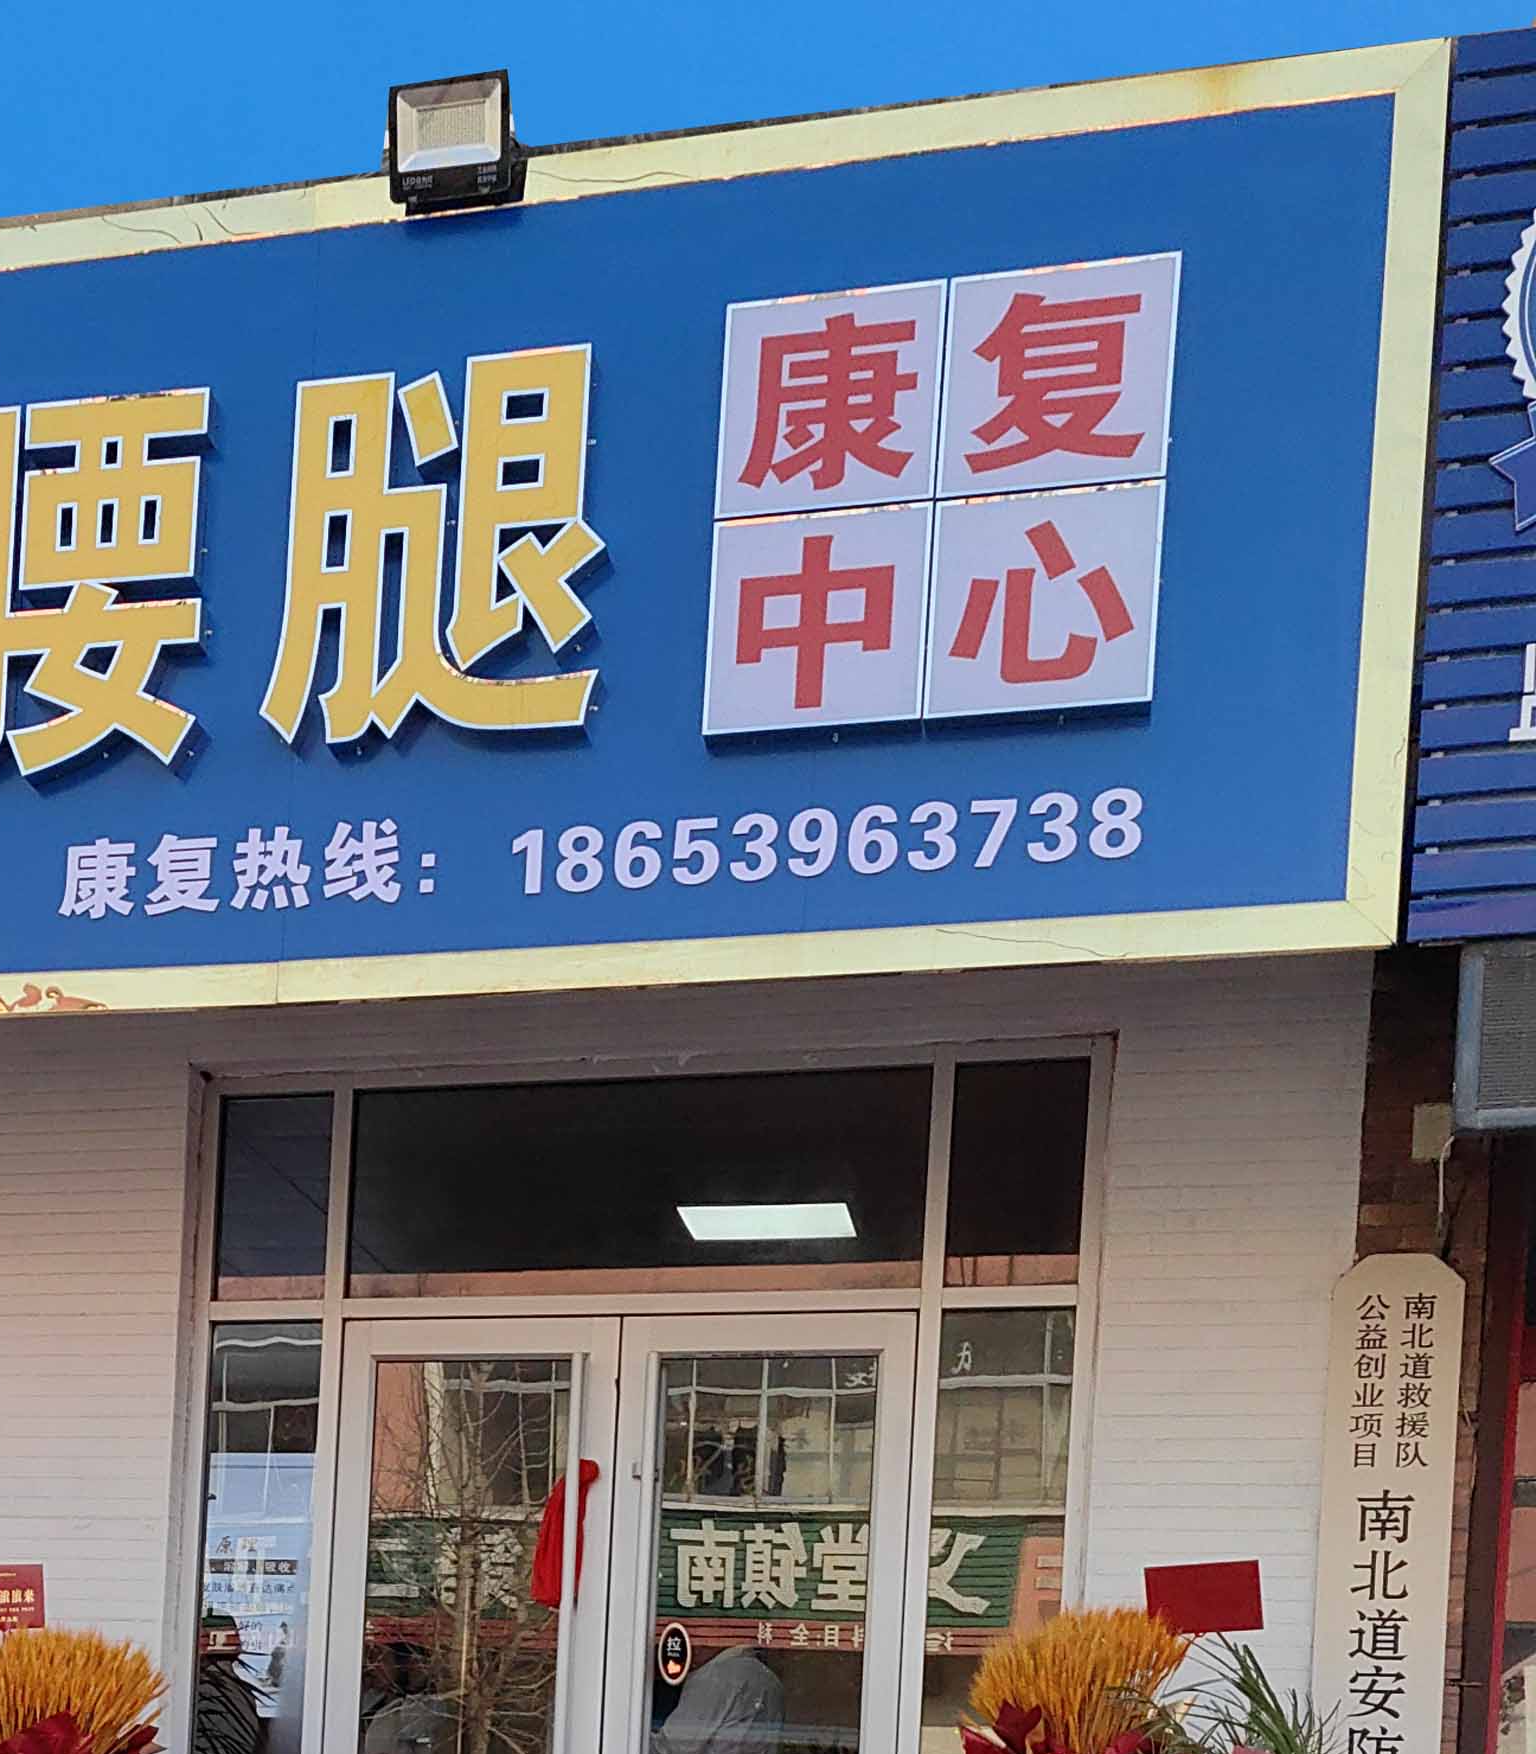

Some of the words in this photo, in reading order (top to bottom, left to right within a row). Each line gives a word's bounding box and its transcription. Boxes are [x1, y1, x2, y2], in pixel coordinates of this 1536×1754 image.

[738, 292, 1145, 490] 康复
[735, 519, 1138, 709] 中心
[511, 787, 1145, 895] 18653963738
[1348, 1293, 1391, 1468] 公益创业项目
[1395, 1292, 1438, 1468] 南北道救援队
